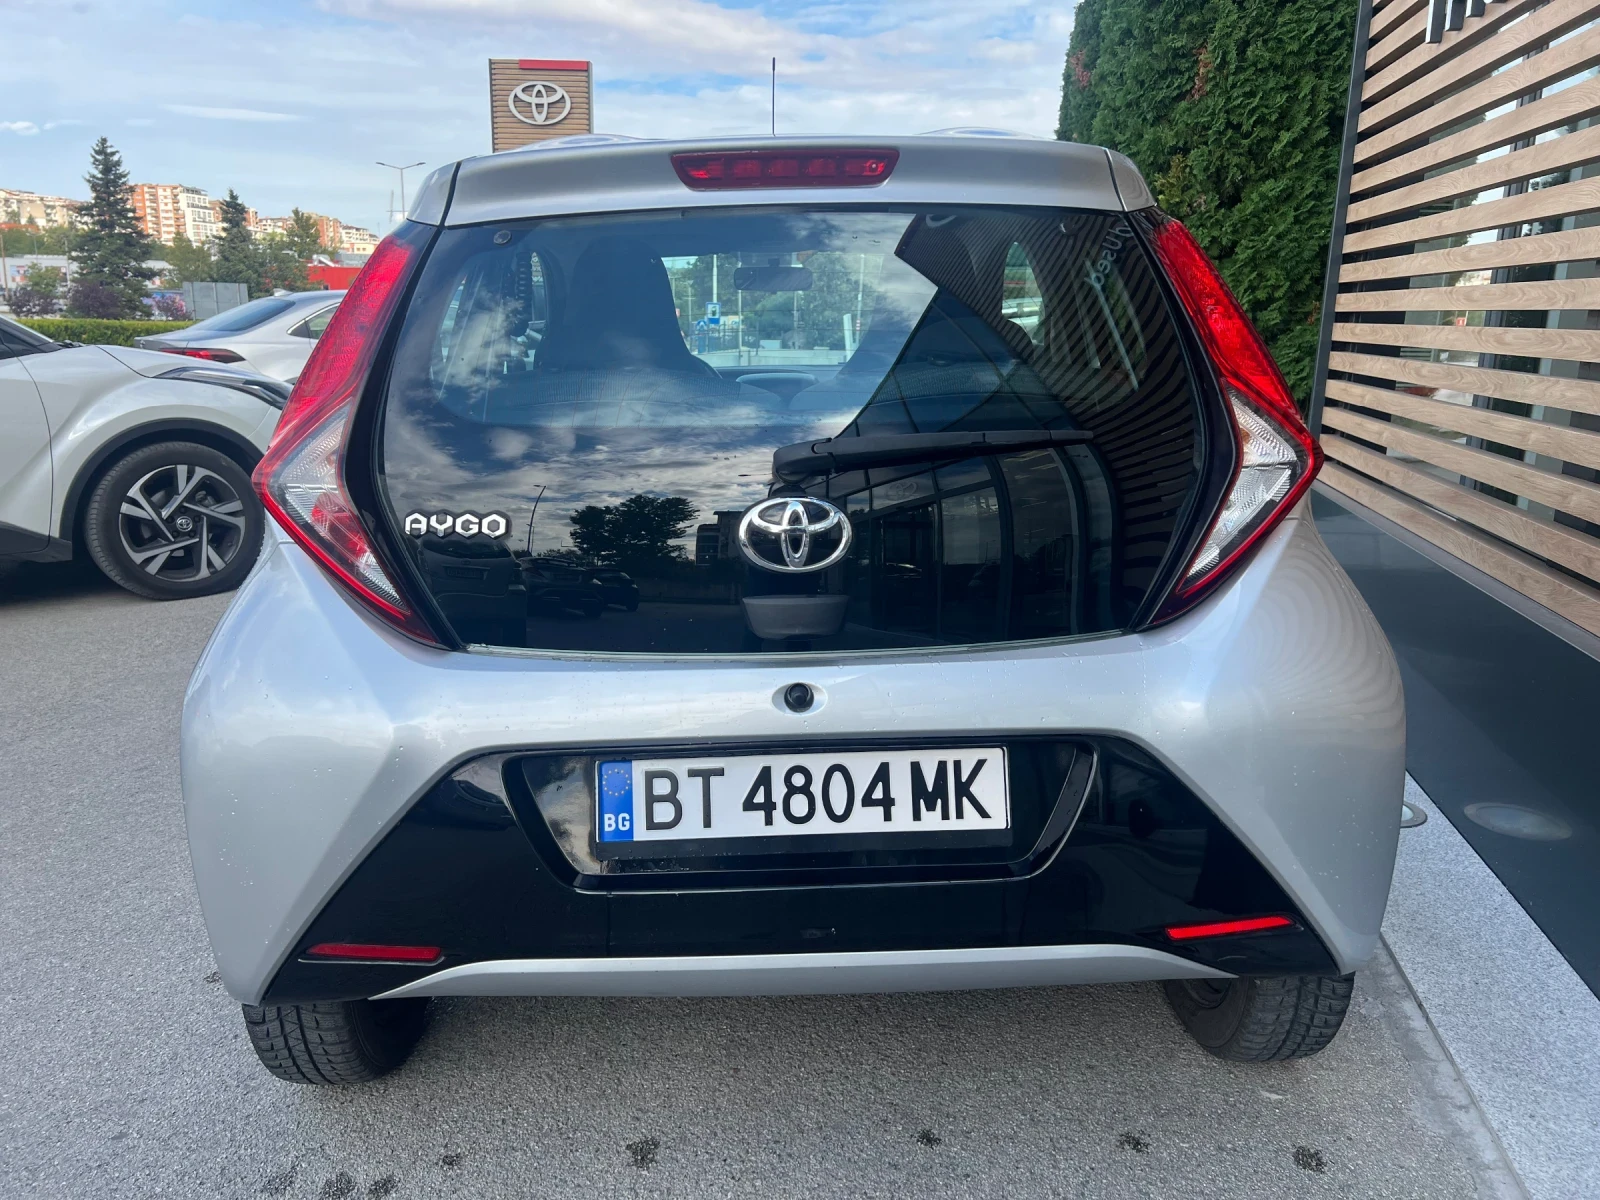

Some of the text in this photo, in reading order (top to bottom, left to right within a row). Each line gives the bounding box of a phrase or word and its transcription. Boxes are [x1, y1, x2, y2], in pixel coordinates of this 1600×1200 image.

[404, 513, 507, 539] AYGO
[645, 758, 992, 831] BT 4804 MK
[603, 813, 631, 832] BG
